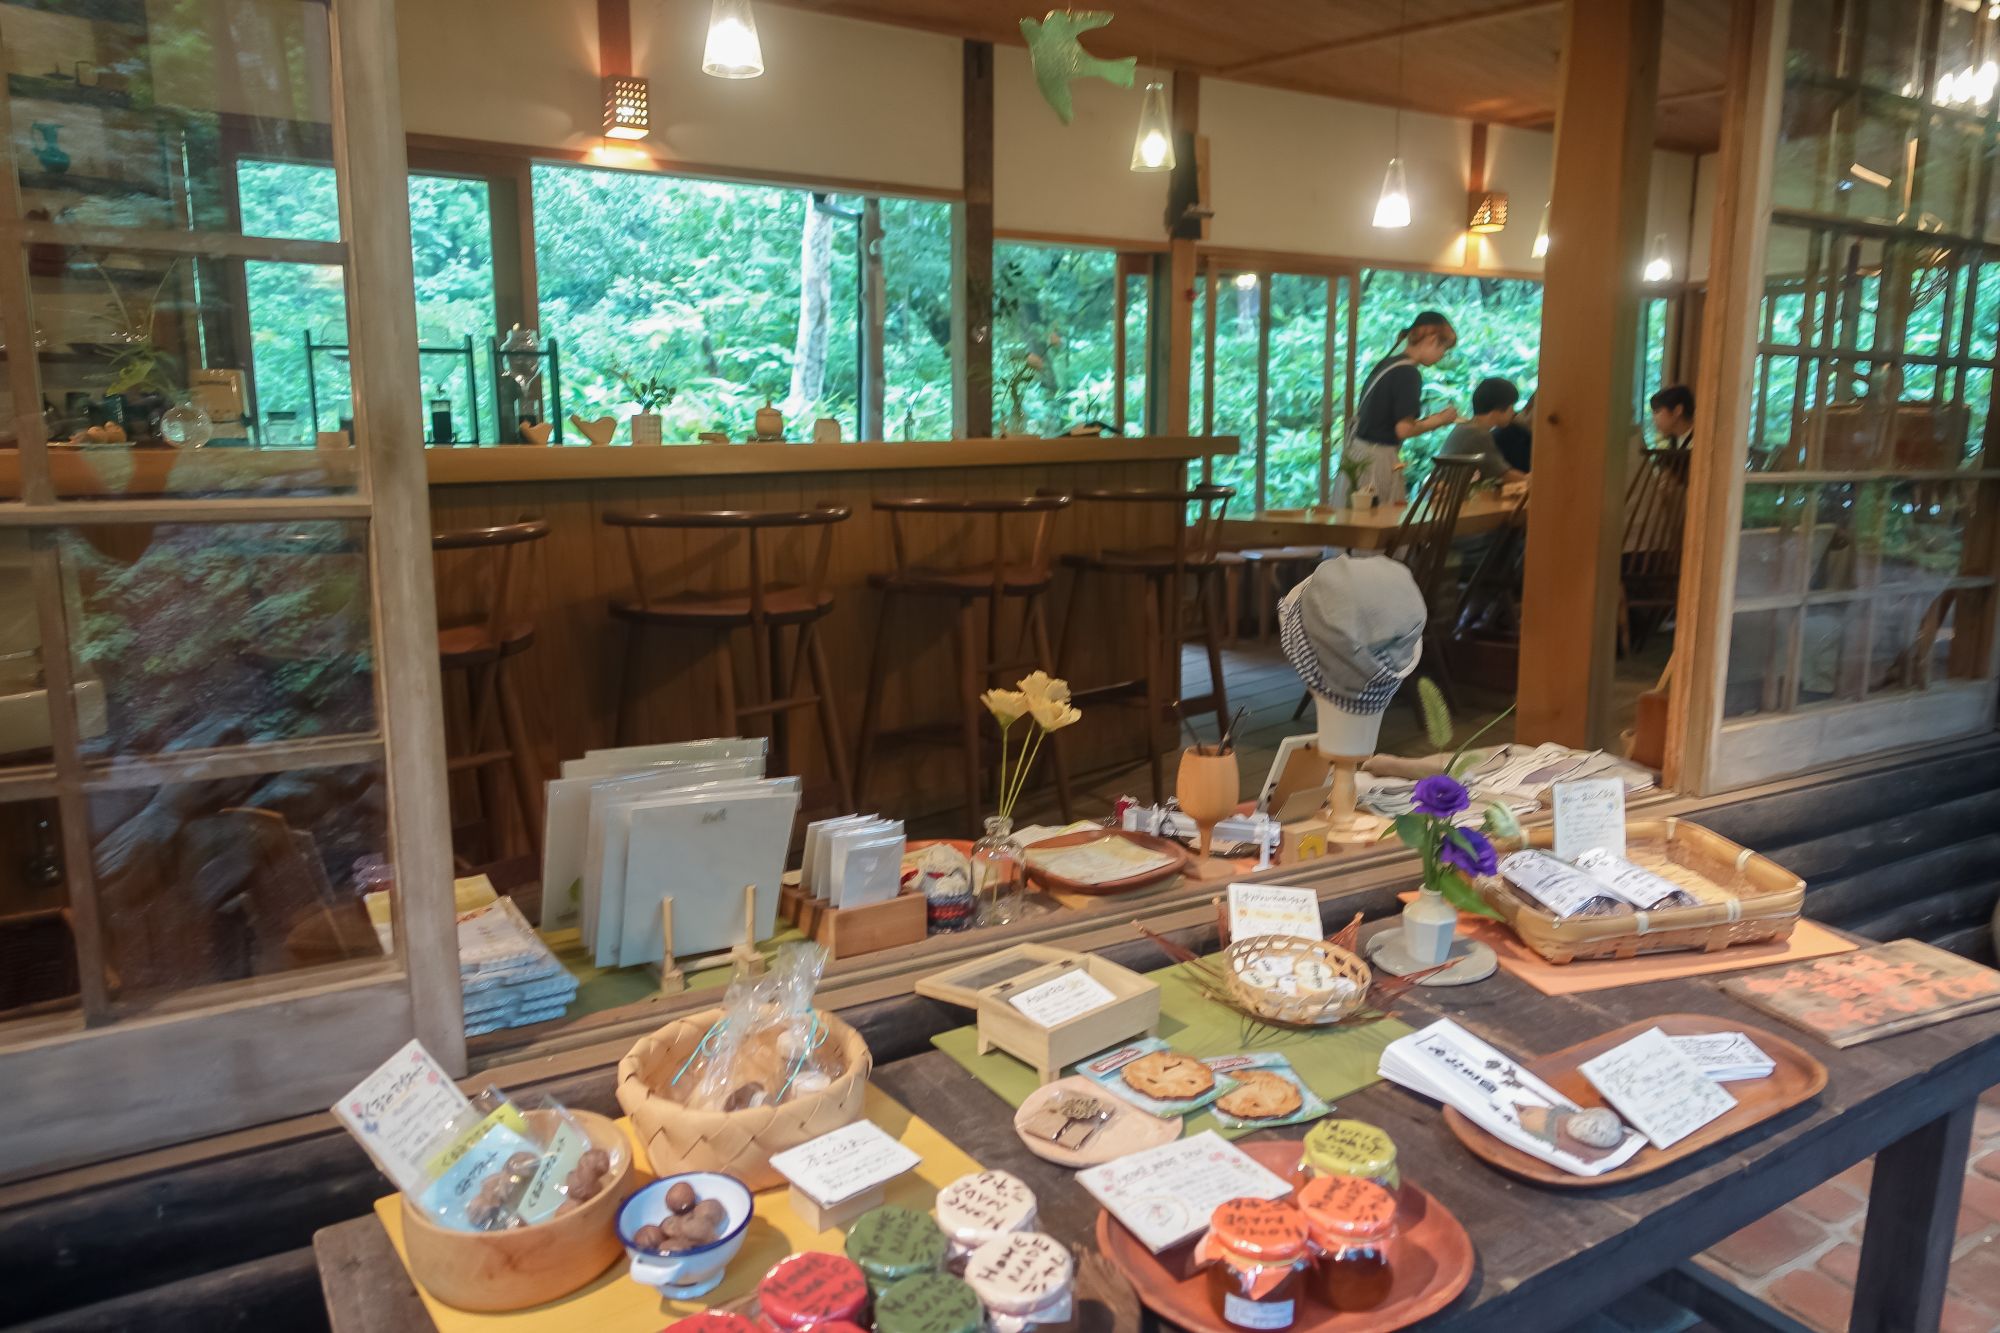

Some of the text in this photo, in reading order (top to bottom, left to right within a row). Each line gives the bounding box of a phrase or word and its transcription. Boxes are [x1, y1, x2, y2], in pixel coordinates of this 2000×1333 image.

[945, 1197, 1006, 1230] HOME
[976, 1235, 1028, 1282] HOME
[1007, 1239, 1050, 1282] MADE
